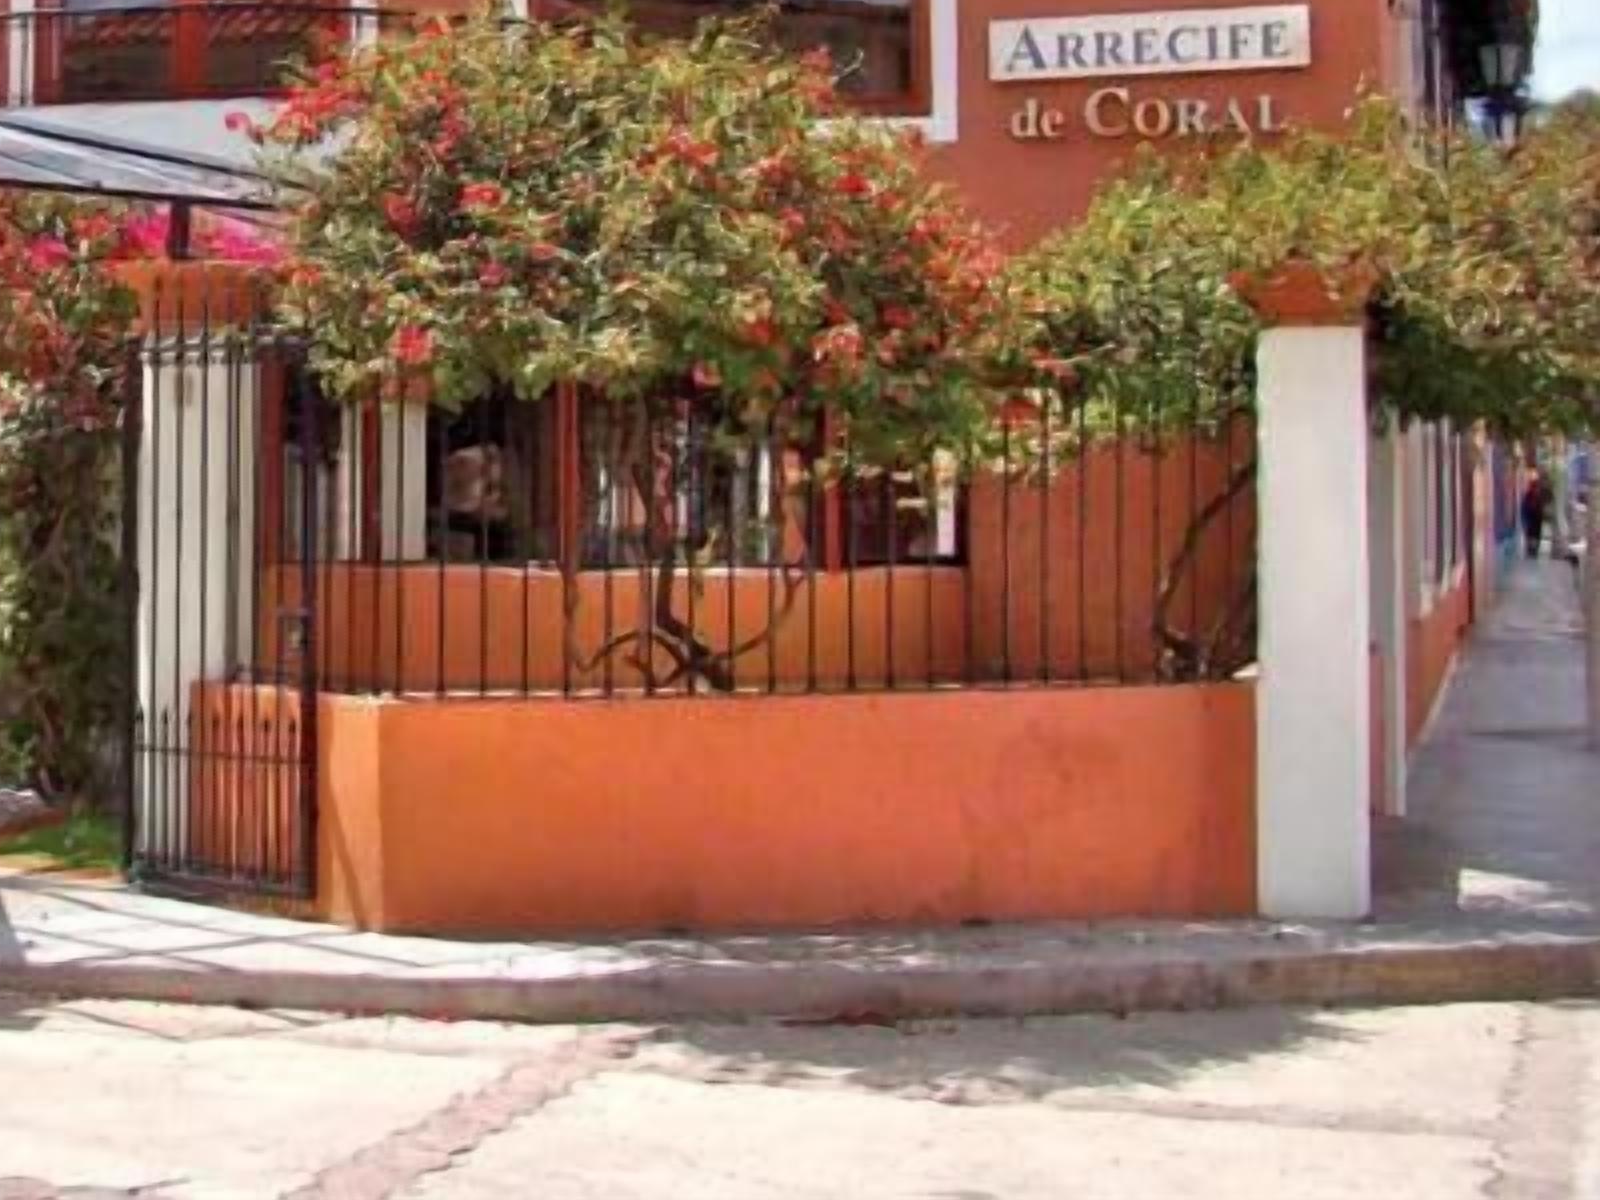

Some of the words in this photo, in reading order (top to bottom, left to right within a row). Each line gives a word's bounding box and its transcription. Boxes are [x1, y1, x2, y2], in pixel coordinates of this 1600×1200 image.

[1005, 19, 1292, 73] ARRECIFE
[1010, 98, 1065, 137] de
[1084, 86, 1285, 138] CORAL
